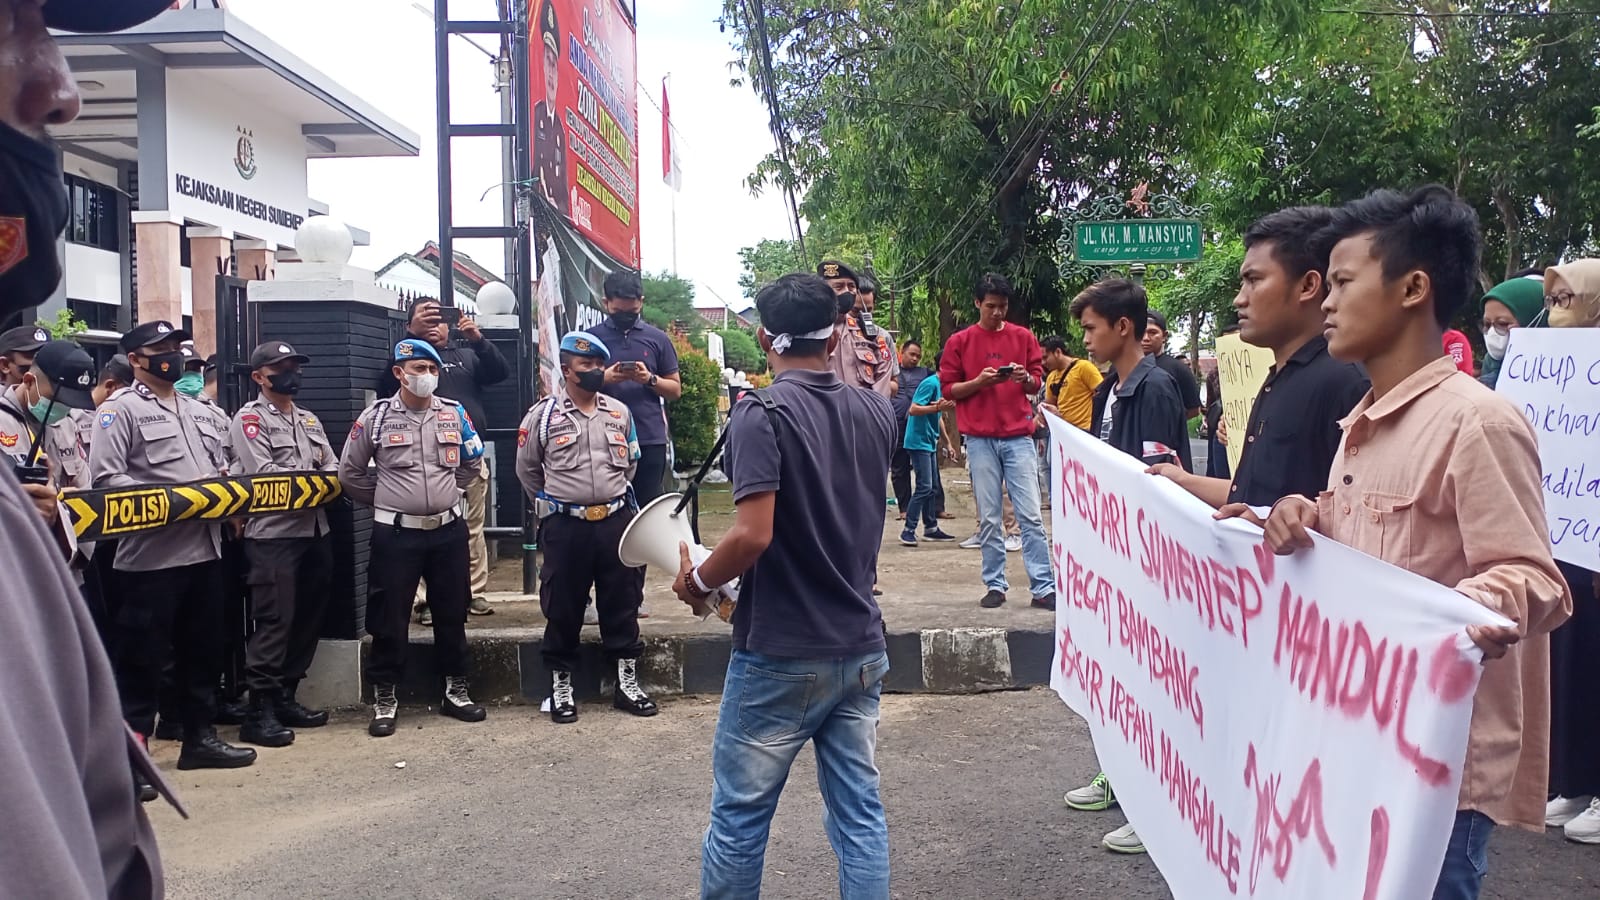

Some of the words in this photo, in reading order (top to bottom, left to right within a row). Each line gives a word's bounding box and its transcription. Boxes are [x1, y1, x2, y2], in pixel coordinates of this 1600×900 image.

[578, 80, 598, 130] ZONA
[176, 173, 234, 210] KEJAKSAAN
[235, 194, 267, 221] NEGERI
[268, 206, 304, 230] SUMENEP
[1084, 227, 1097, 245] JL.
[1101, 226, 1120, 245] KH.
[1123, 226, 1135, 244] M.
[1139, 224, 1193, 244] MANSYUR
[438, 422, 459, 430] POLRI
[605, 422, 626, 432] POLRI
[109, 495, 167, 527] POLISI
[254, 482, 288, 506] POLISI
[1060, 443, 1131, 561] KEJARI
[1137, 507, 1262, 648] SUMENEP
[1067, 551, 1113, 647] PECAT
[1117, 588, 1203, 740] BAMBANG
[1109, 675, 1155, 774] IRFAN
[1161, 729, 1242, 895] MANGALLE
